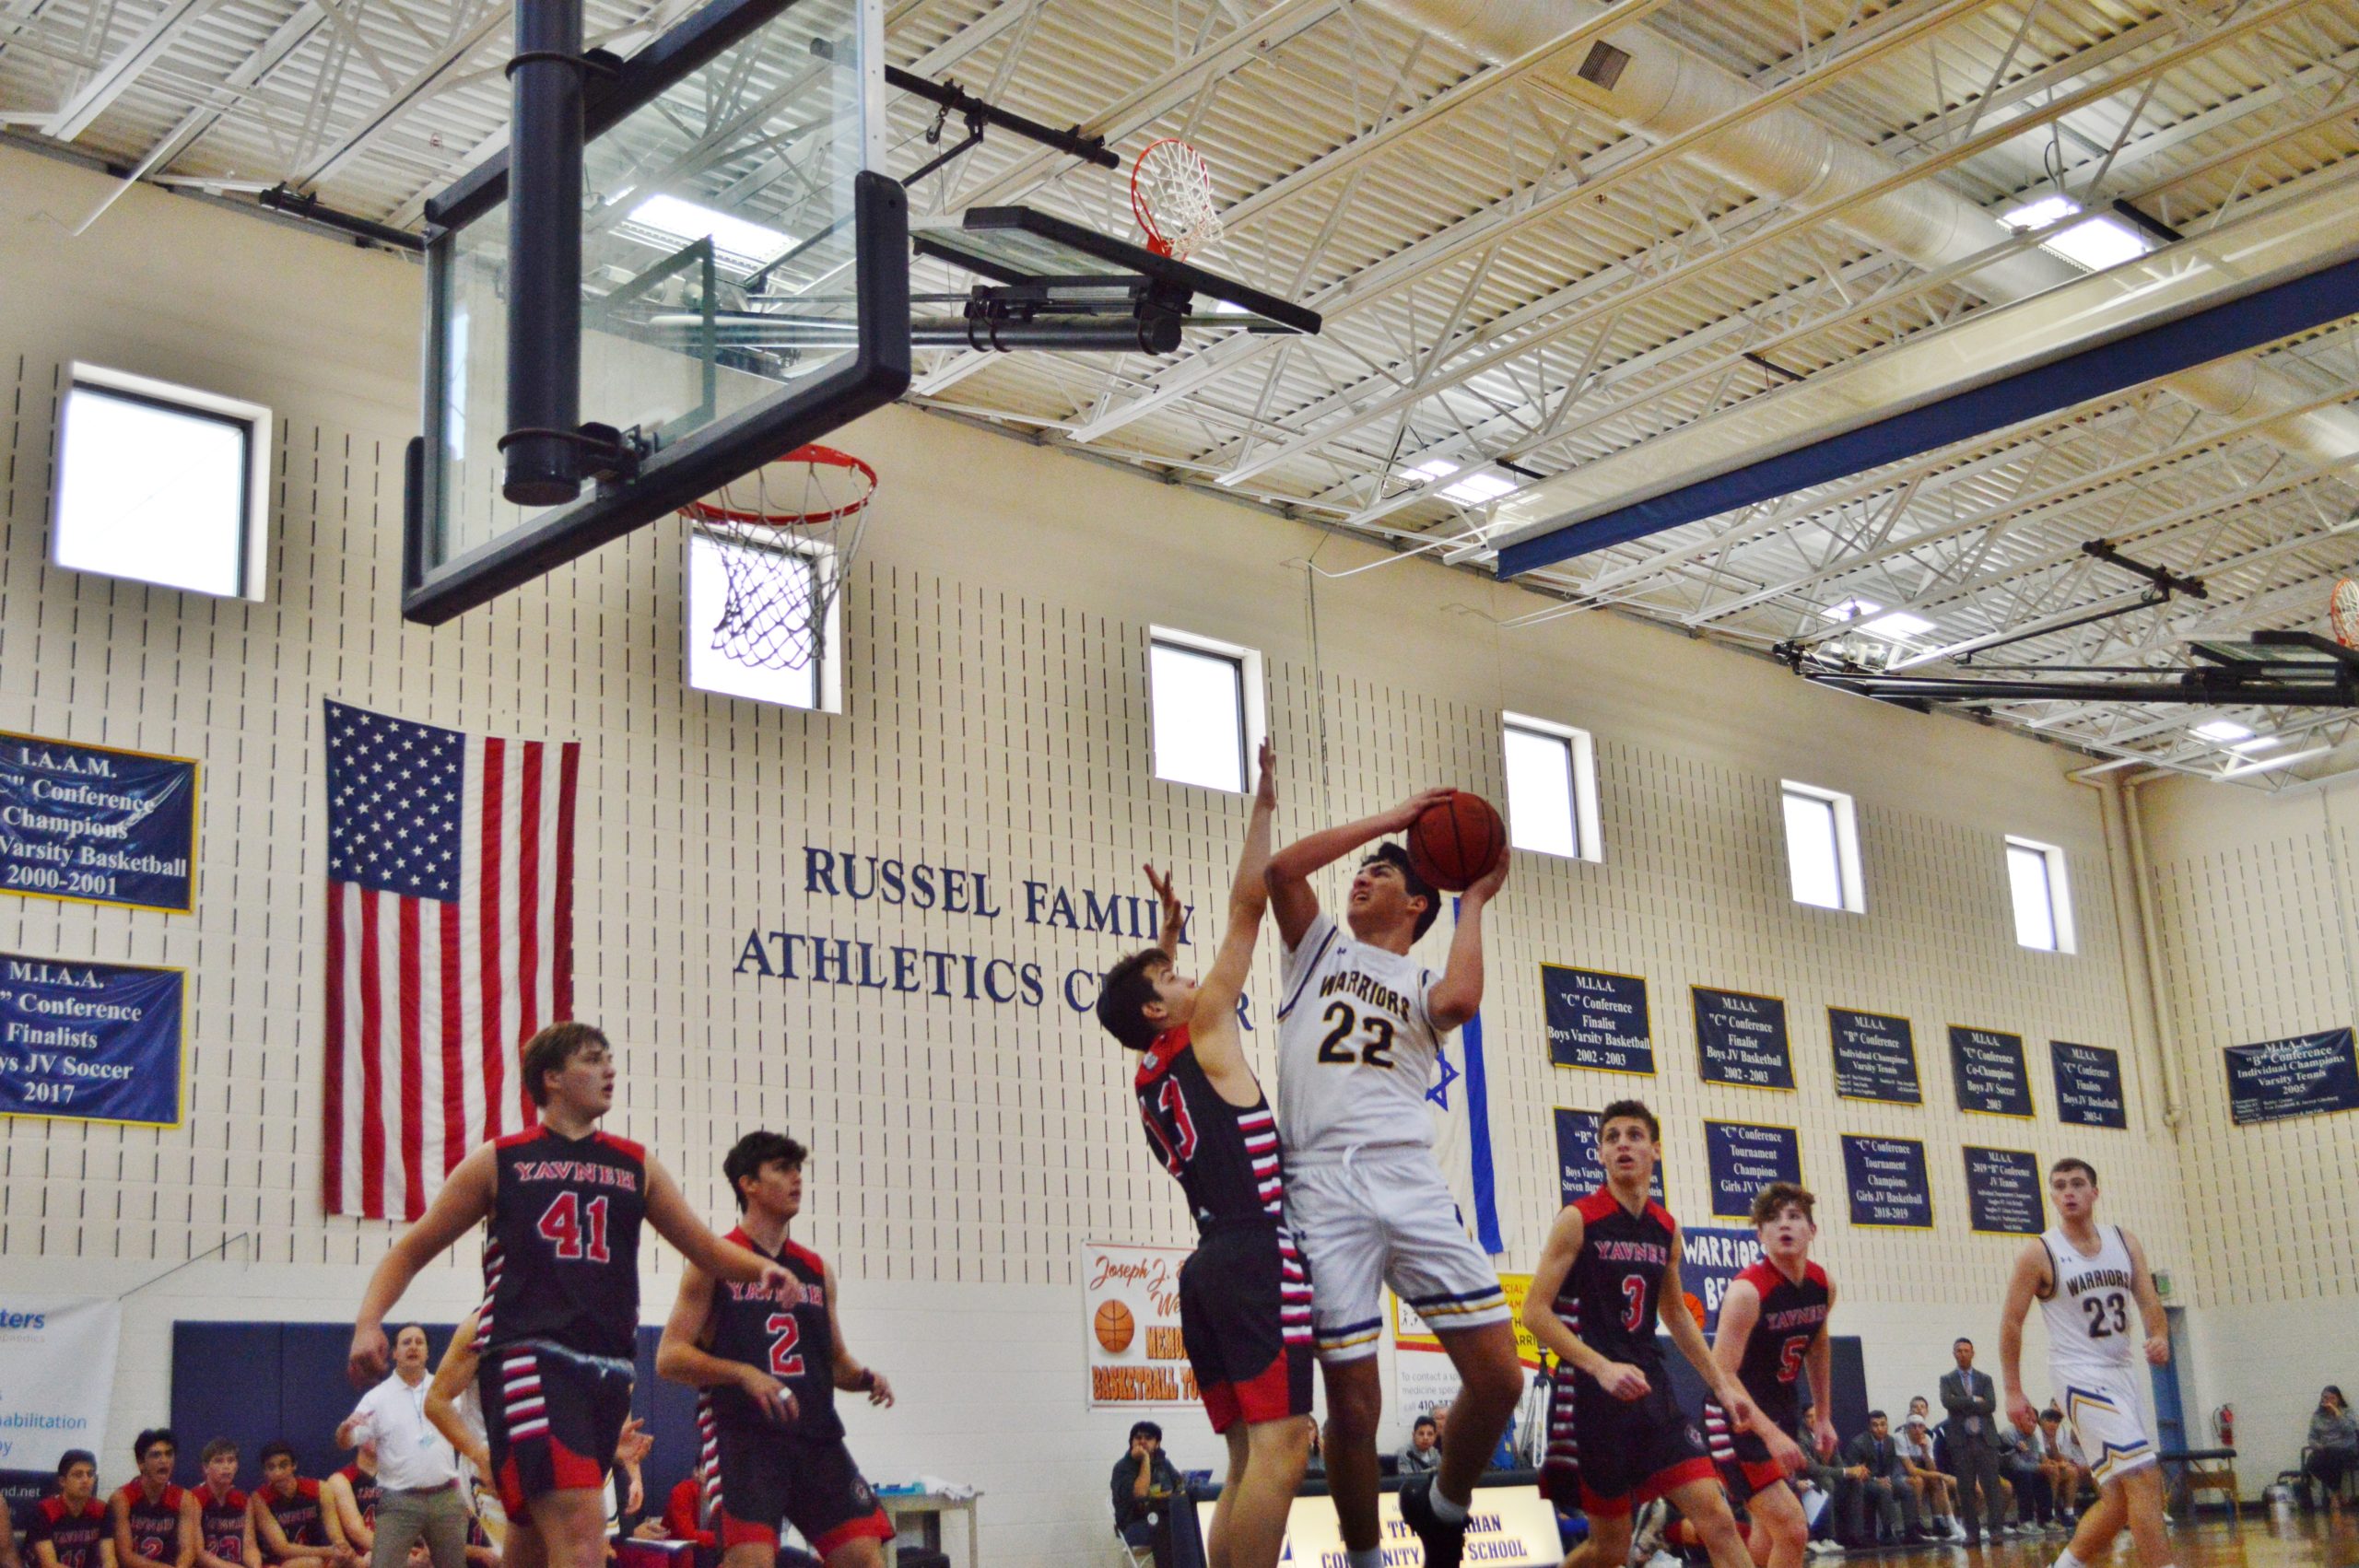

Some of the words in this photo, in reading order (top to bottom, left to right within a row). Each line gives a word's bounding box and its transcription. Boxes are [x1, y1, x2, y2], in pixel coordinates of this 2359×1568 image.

[33, 779, 154, 813] Conference
[3, 806, 128, 839] Champions
[0, 836, 74, 867] Varsity
[80, 846, 186, 877] Basketball
[7, 865, 116, 895] 2000-2001
[803, 847, 1001, 918] RUSSEL
[9, 961, 104, 989] M.I.A.A.
[734, 929, 1044, 1008] ATHLETICS
[1319, 969, 1410, 1021] WARRIORS
[1576, 976, 1615, 992] M.I.A.A.
[19, 993, 142, 1022] Conference
[1582, 996, 1633, 1013] Conference
[1722, 997, 1757, 1012] M.I.A.A.
[1582, 1014, 1616, 1030] Finalist
[1729, 1015, 1773, 1033] Conference
[7, 1023, 98, 1048] Finalists
[1318, 1000, 1396, 1069] 22
[1547, 1025, 1570, 1043] Boys
[1571, 1028, 1602, 1045] Varsity
[1605, 1033, 1651, 1050] Basketball
[1728, 1034, 1758, 1048] Finalist
[1860, 1033, 1900, 1048] Conference
[26, 1054, 57, 1073] JV
[64, 1056, 134, 1079] Soccer
[1707, 1046, 1726, 1061] Boys
[1727, 1048, 1739, 1060] JV
[1741, 1050, 1782, 1067] Basketball
[1839, 1047, 1872, 1060] Individual
[1873, 1052, 1908, 1065] Champions
[1977, 1048, 2014, 1064] Conference
[2237, 1064, 2287, 1078] Individual
[2289, 1055, 2345, 1071] Champions
[2271, 1047, 2332, 1063] Conference
[1852, 1060, 1876, 1073] Varsity
[1876, 1064, 1897, 1075] Tennis
[2258, 1074, 2292, 1086] Varsity
[2294, 1070, 2327, 1082] Tennis
[24, 1082, 75, 1104] 2017
[1739, 1127, 1782, 1142] Conference
[1729, 1144, 1778, 1160] Tournament
[1872, 1141, 1910, 1154] Conference
[1733, 1163, 1778, 1179] Champions
[1863, 1157, 1907, 1170] Tournament
[514, 1161, 636, 1192] YAVNEH
[1720, 1179, 1742, 1192] Girls
[1743, 1181, 1754, 1193] JV
[1868, 1175, 1907, 1188] Champions
[1856, 1189, 1874, 1202] Girls
[1886, 1191, 1922, 1204] Basketball
[537, 1190, 610, 1264] 41
[1681, 1235, 1766, 1269] WARRIOR
[1090, 1256, 1151, 1291] Joseph
[2066, 1269, 2130, 1297] WARRIORS
[1622, 1274, 1646, 1332] 3
[2083, 1293, 2127, 1338] 23
[766, 1313, 805, 1375] 2
[1777, 1335, 1808, 1382] 5
[1091, 1365, 1179, 1401] BASKETBALL
[1412, 1373, 1440, 1381] contact
[1402, 1386, 1434, 1394] medicine
[1468, 1539, 1527, 1562] SCHOOL
